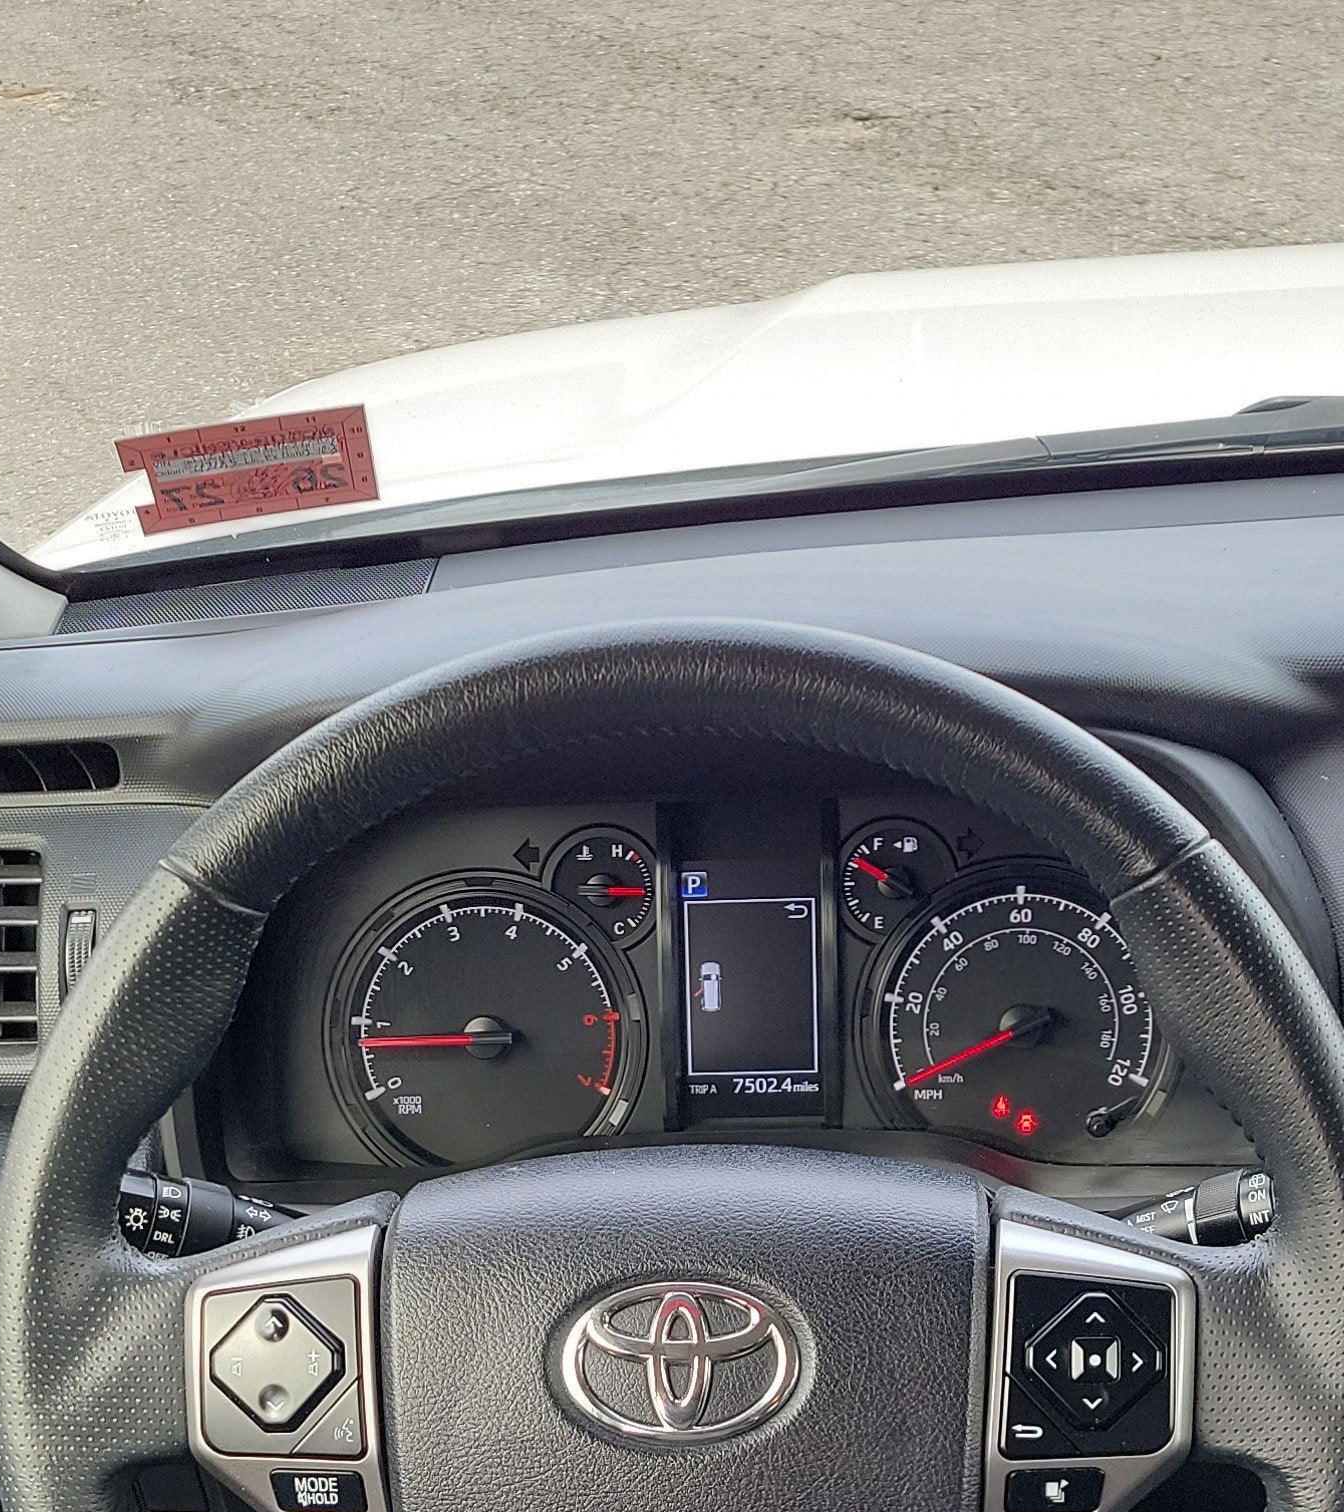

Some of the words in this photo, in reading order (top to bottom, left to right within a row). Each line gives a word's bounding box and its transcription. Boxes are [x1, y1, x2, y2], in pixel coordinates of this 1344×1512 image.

[611, 844, 623, 858] H
[873, 838, 883, 851] F
[687, 875, 702, 895] P
[874, 916, 884, 929] E
[1009, 908, 1032, 923] 60
[447, 927, 461, 942] 3
[505, 926, 519, 940] 4
[613, 922, 625, 936] C
[942, 931, 964, 952] 40
[983, 938, 1000, 952] 80
[1016, 934, 1038, 945] 100
[1076, 927, 1101, 949] 80
[1052, 941, 1072, 957] 120
[397, 960, 415, 977] 2
[556, 957, 573, 973] 5
[954, 957, 969, 972] 60
[1080, 961, 1098, 981] 140
[934, 986, 948, 1001] 40
[1117, 984, 1139, 1016] 100
[905, 991, 923, 1015] 20
[1098, 992, 1111, 1013] 160
[376, 1020, 391, 1029] 1
[929, 1022, 940, 1037] 20
[1099, 1029, 1113, 1049] 180
[938, 1073, 964, 1085] km/h
[1107, 1057, 1131, 1088] 120
[386, 1076, 402, 1090] 0
[689, 1084, 709, 1095] TRIP
[709, 1085, 717, 1094] A
[732, 1078, 792, 1094] 7502.4
[792, 1081, 819, 1092] miles
[392, 1096, 422, 1105] x1000
[914, 1089, 943, 1101] MPH
[398, 1104, 422, 1115] RPM
[1248, 1189, 1266, 1203] ON
[1136, 1211, 1156, 1224] MIST
[1249, 1210, 1271, 1226] INT
[153, 1231, 175, 1245] DRL
[294, 1477, 338, 1492] MODE
[307, 1491, 338, 1506] HOLD
